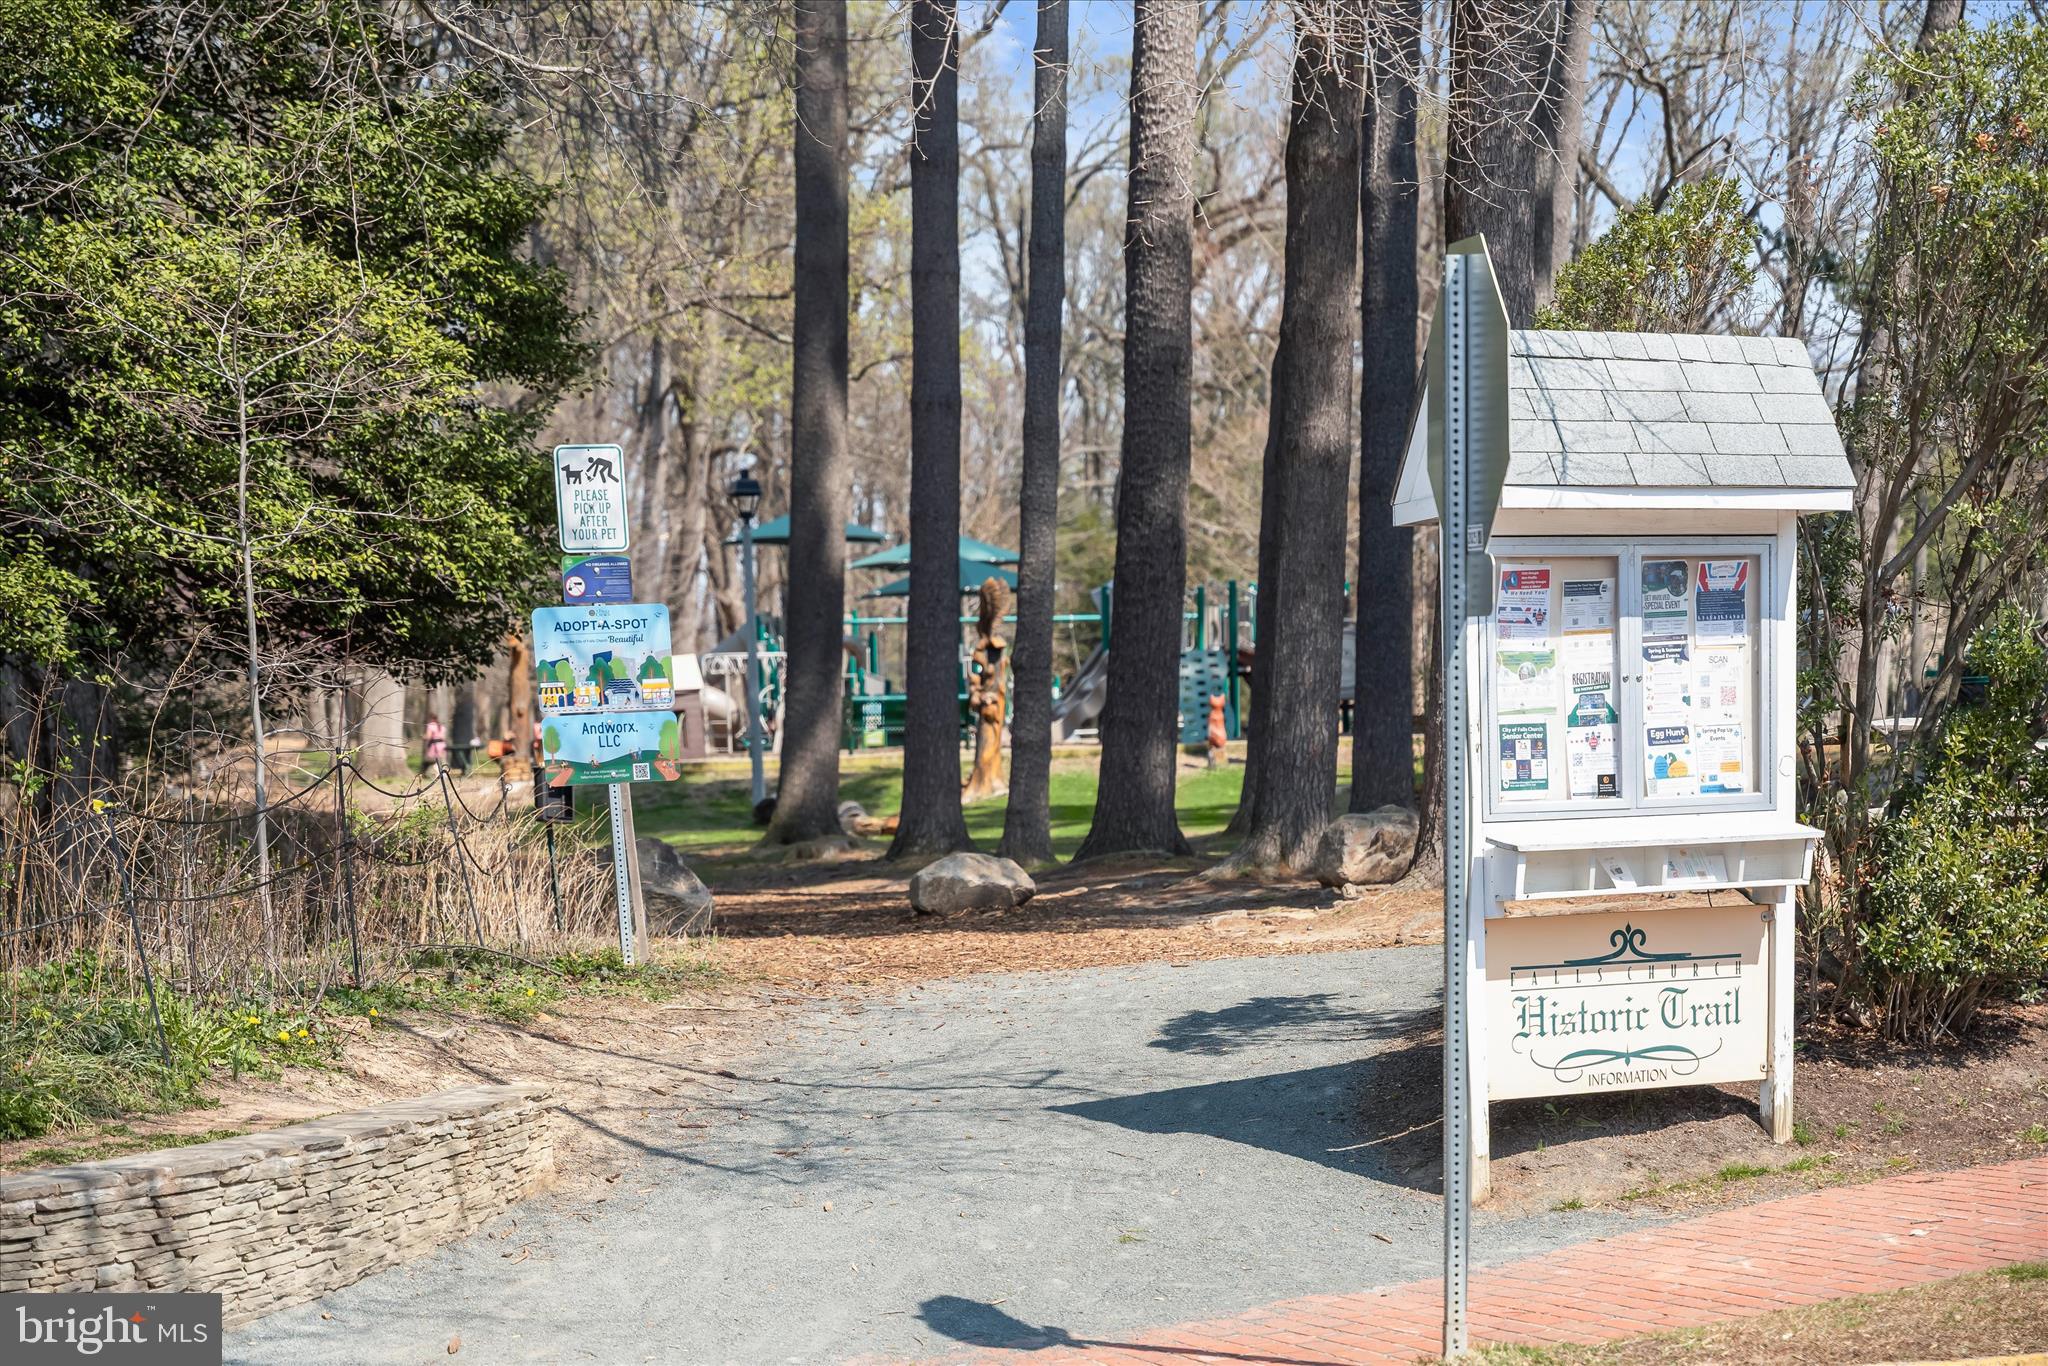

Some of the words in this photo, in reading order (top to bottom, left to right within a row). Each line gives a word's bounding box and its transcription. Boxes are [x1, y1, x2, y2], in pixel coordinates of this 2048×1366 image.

[574, 489, 609, 501] PLEASE
[573, 503, 595, 514] PICK
[599, 502, 611, 514] UP
[580, 515, 608, 527] AFTER
[572, 529, 598, 540] YOUR
[601, 528, 617, 540] PET
[1644, 601, 1664, 610] SPECIAL
[1665, 600, 1681, 609] EVENT
[554, 618, 648, 632] ADOPT-A-SPOT
[608, 634, 644, 646] Beautiful
[1708, 656, 1728, 664] SCAN
[1572, 672, 1611, 685] REGISTRATION
[1650, 730, 1664, 739] Egg
[1665, 728, 1685, 737] Hunt
[598, 735, 621, 748] LLC
[1510, 966, 1604, 987] FALLS
[1626, 960, 1742, 981] CHURCH
[1511, 994, 1650, 1041] Historic
[1657, 985, 1742, 1030] Trail
[1588, 1068, 1668, 1088] INFORMATION
